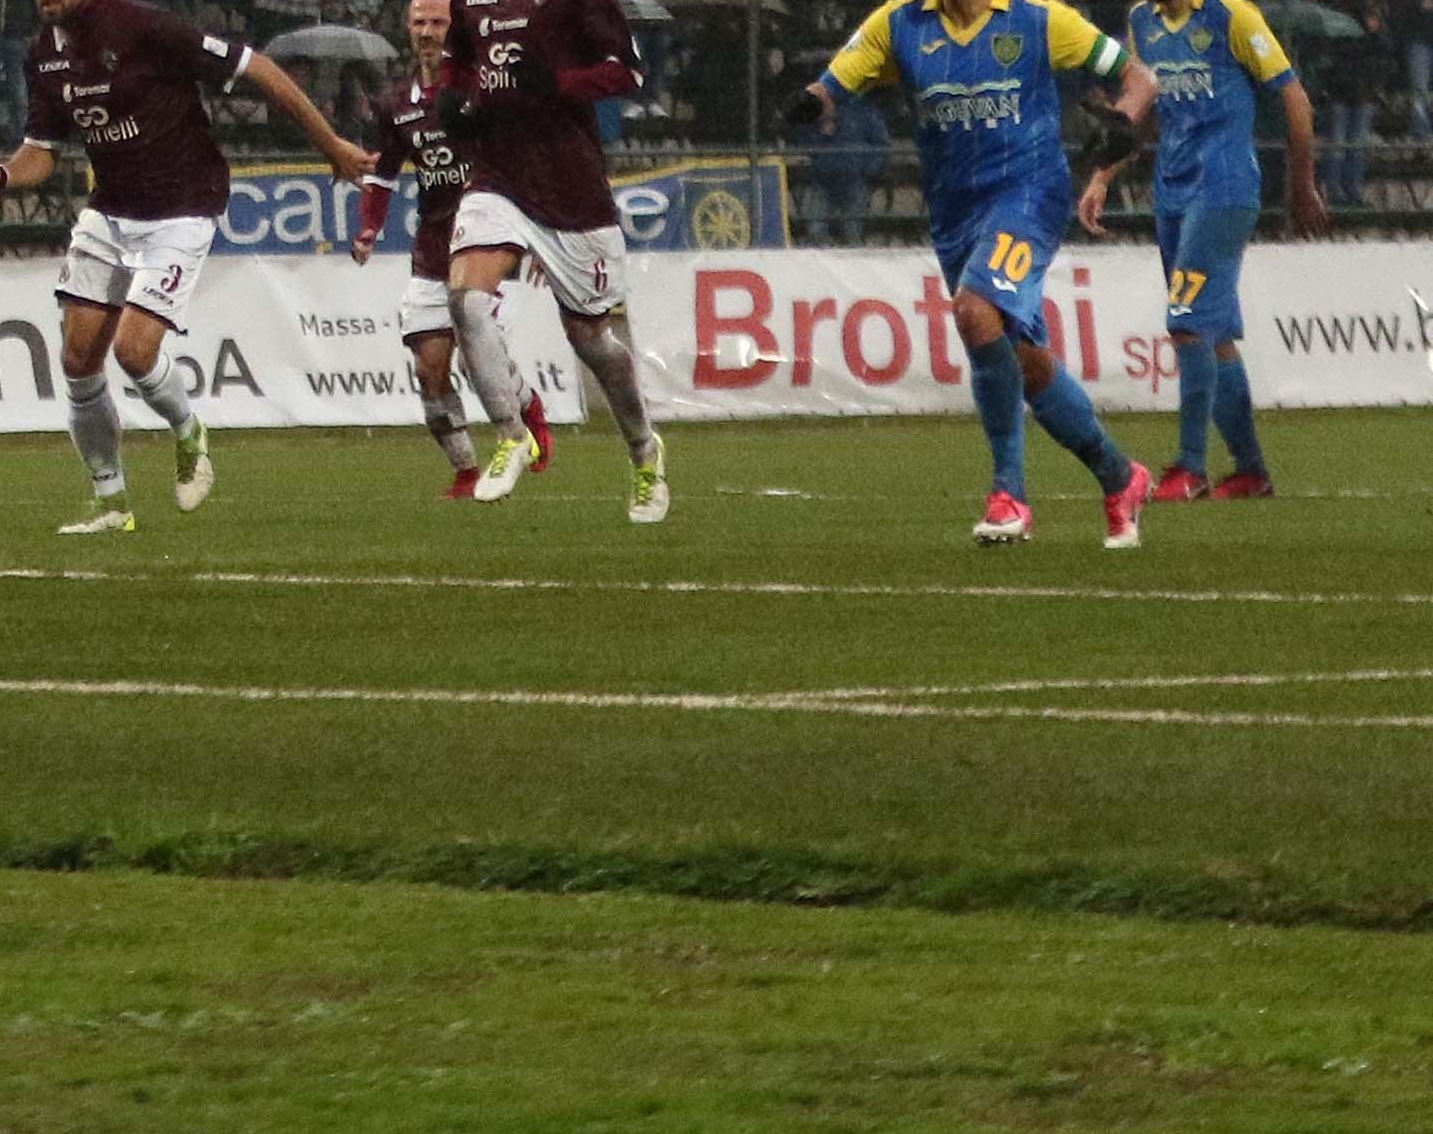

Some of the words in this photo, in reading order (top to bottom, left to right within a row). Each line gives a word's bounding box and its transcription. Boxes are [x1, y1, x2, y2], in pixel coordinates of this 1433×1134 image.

[988, 232, 1033, 283] 10
[160, 264, 183, 294] 3
[298, 314, 377, 338] Massa
